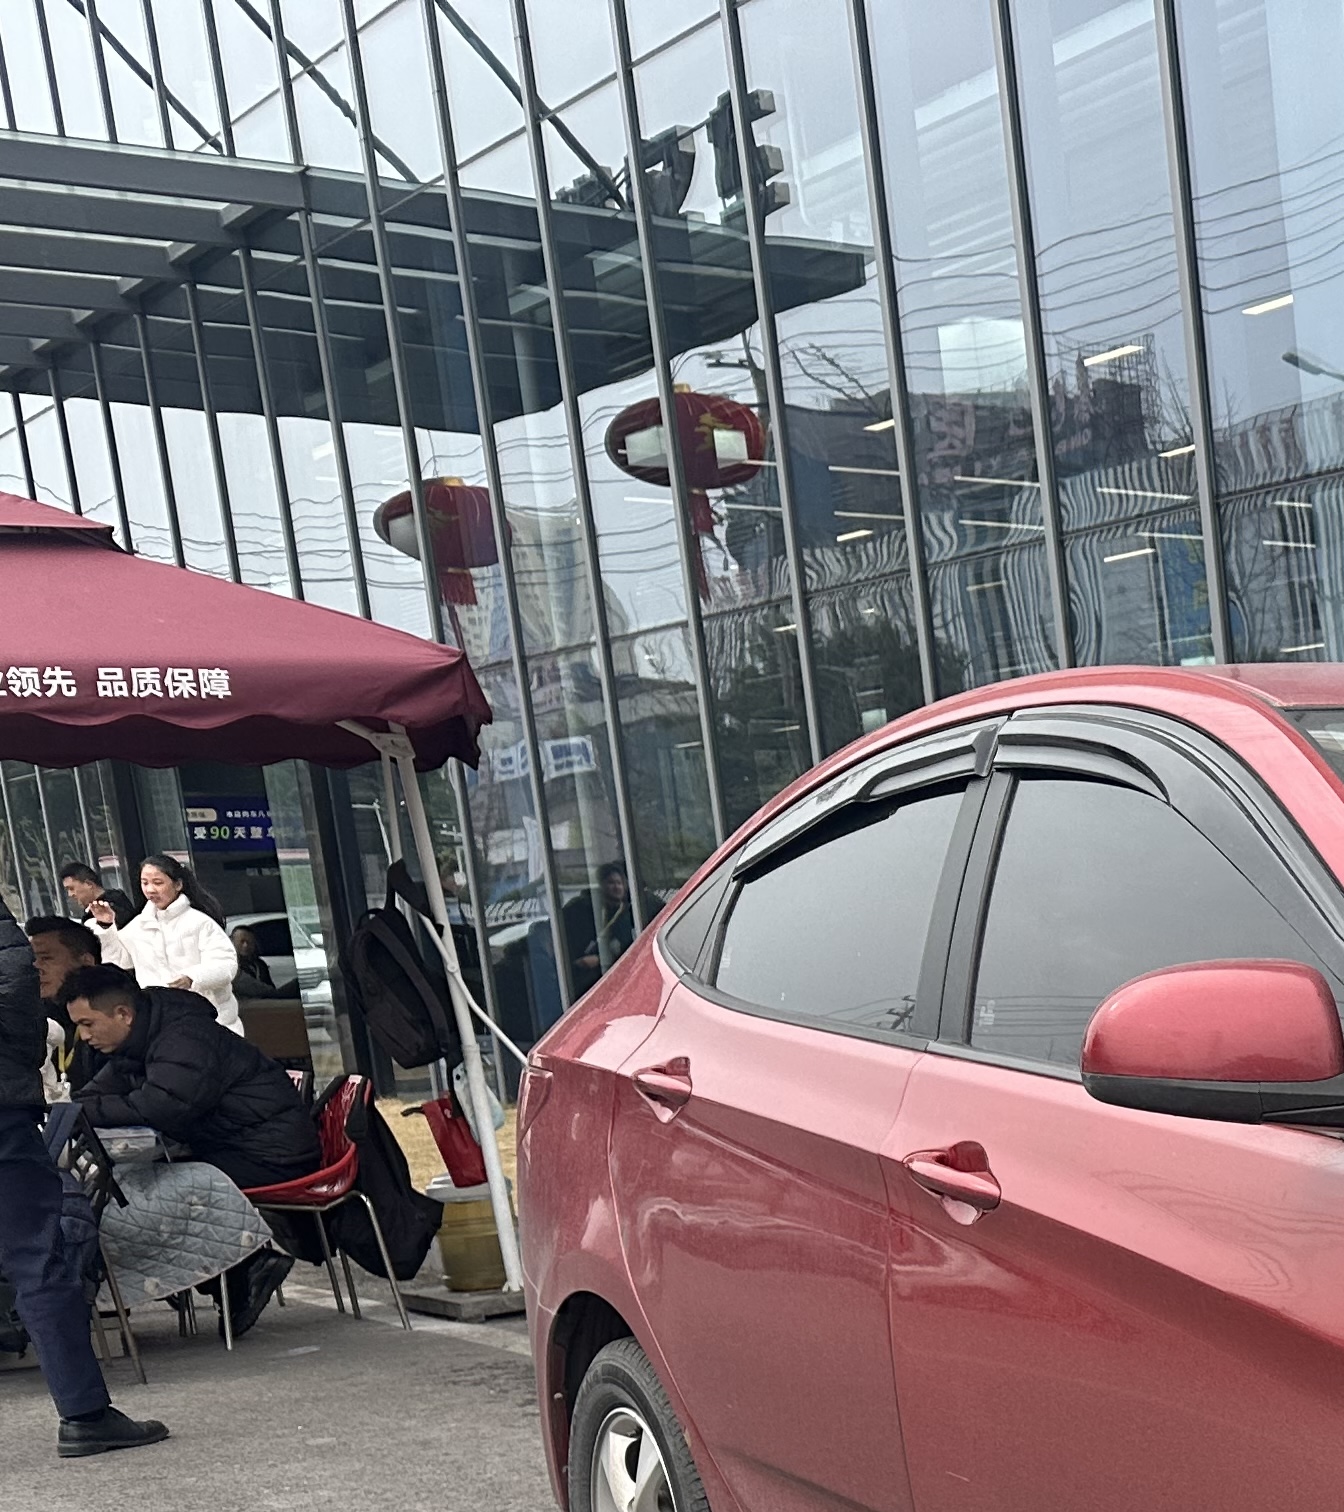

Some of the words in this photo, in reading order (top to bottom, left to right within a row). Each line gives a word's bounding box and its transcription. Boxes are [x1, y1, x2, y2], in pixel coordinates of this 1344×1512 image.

[0, 666, 77, 697] 领先
[97, 667, 232, 699] 品质保障
